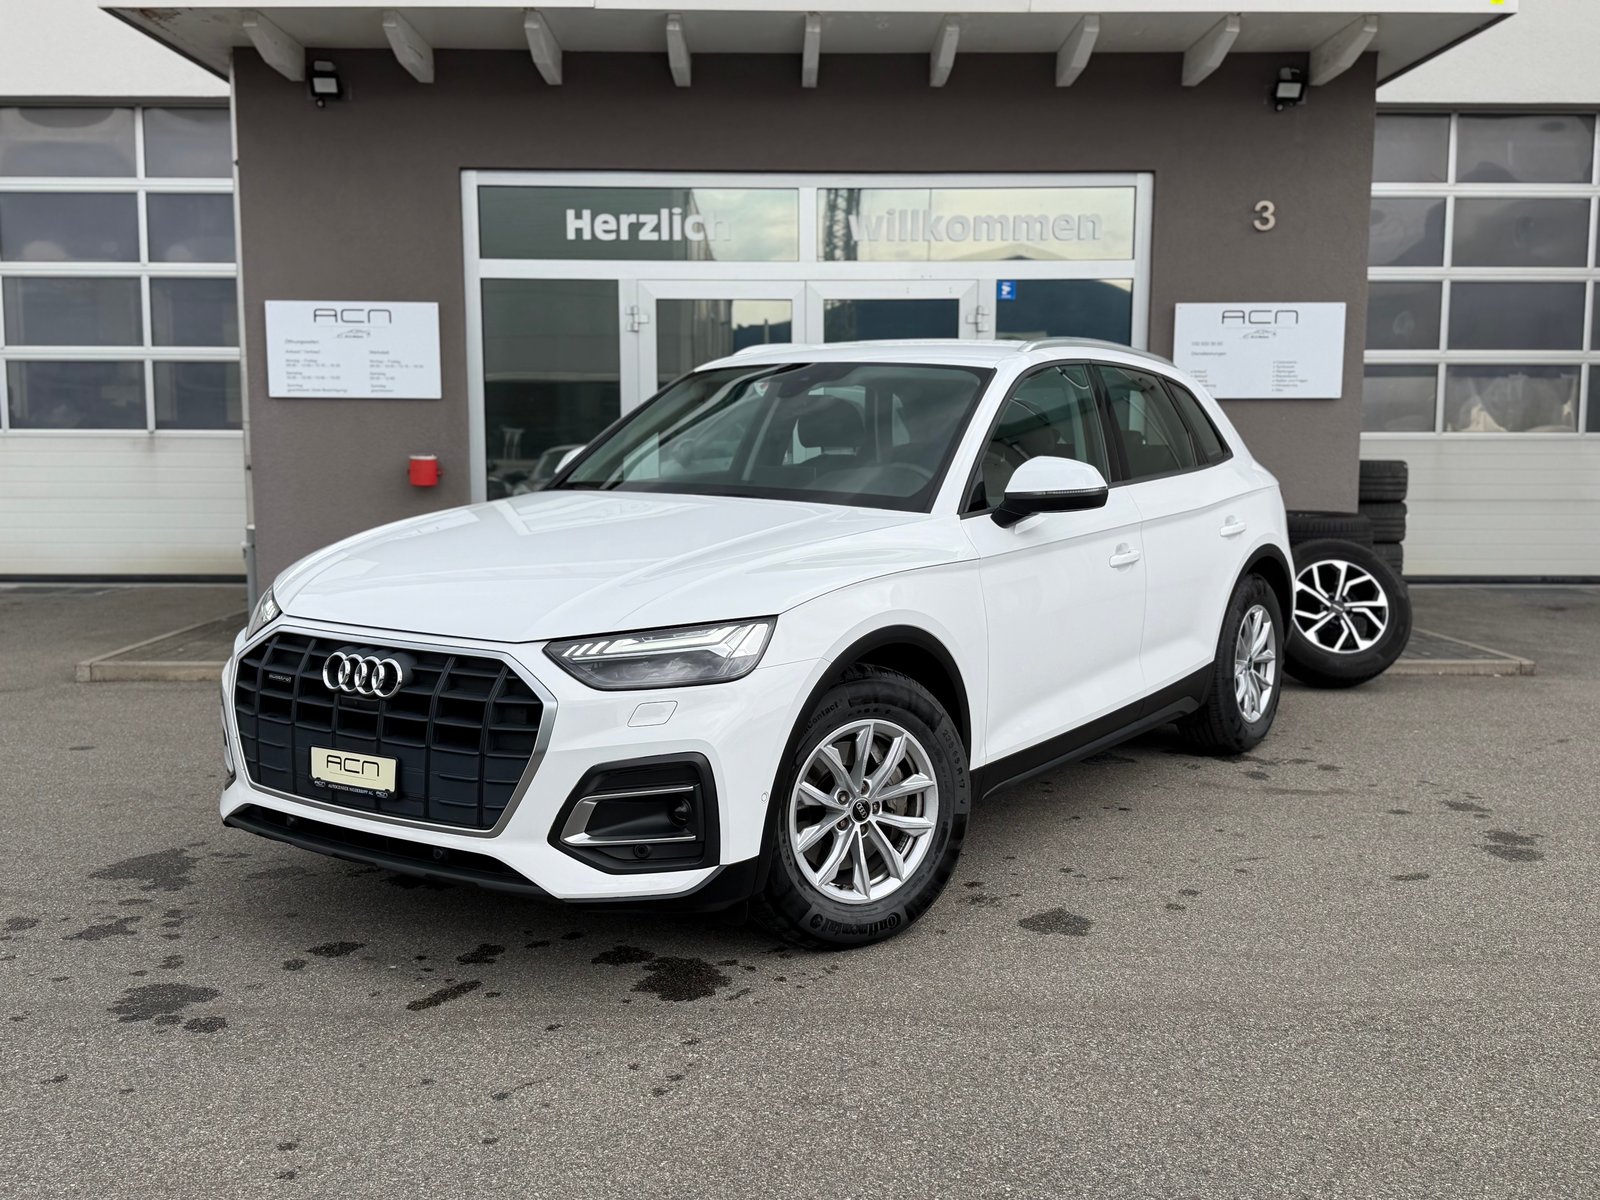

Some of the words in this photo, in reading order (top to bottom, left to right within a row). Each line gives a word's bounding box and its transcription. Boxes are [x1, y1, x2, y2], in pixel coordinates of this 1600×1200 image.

[565, 207, 732, 243] Herzlich
[849, 209, 1103, 244] willkommen
[1253, 200, 1276, 232] 3
[314, 308, 392, 324] ACN
[1222, 310, 1299, 324] ACN
[326, 754, 380, 777] ACN
